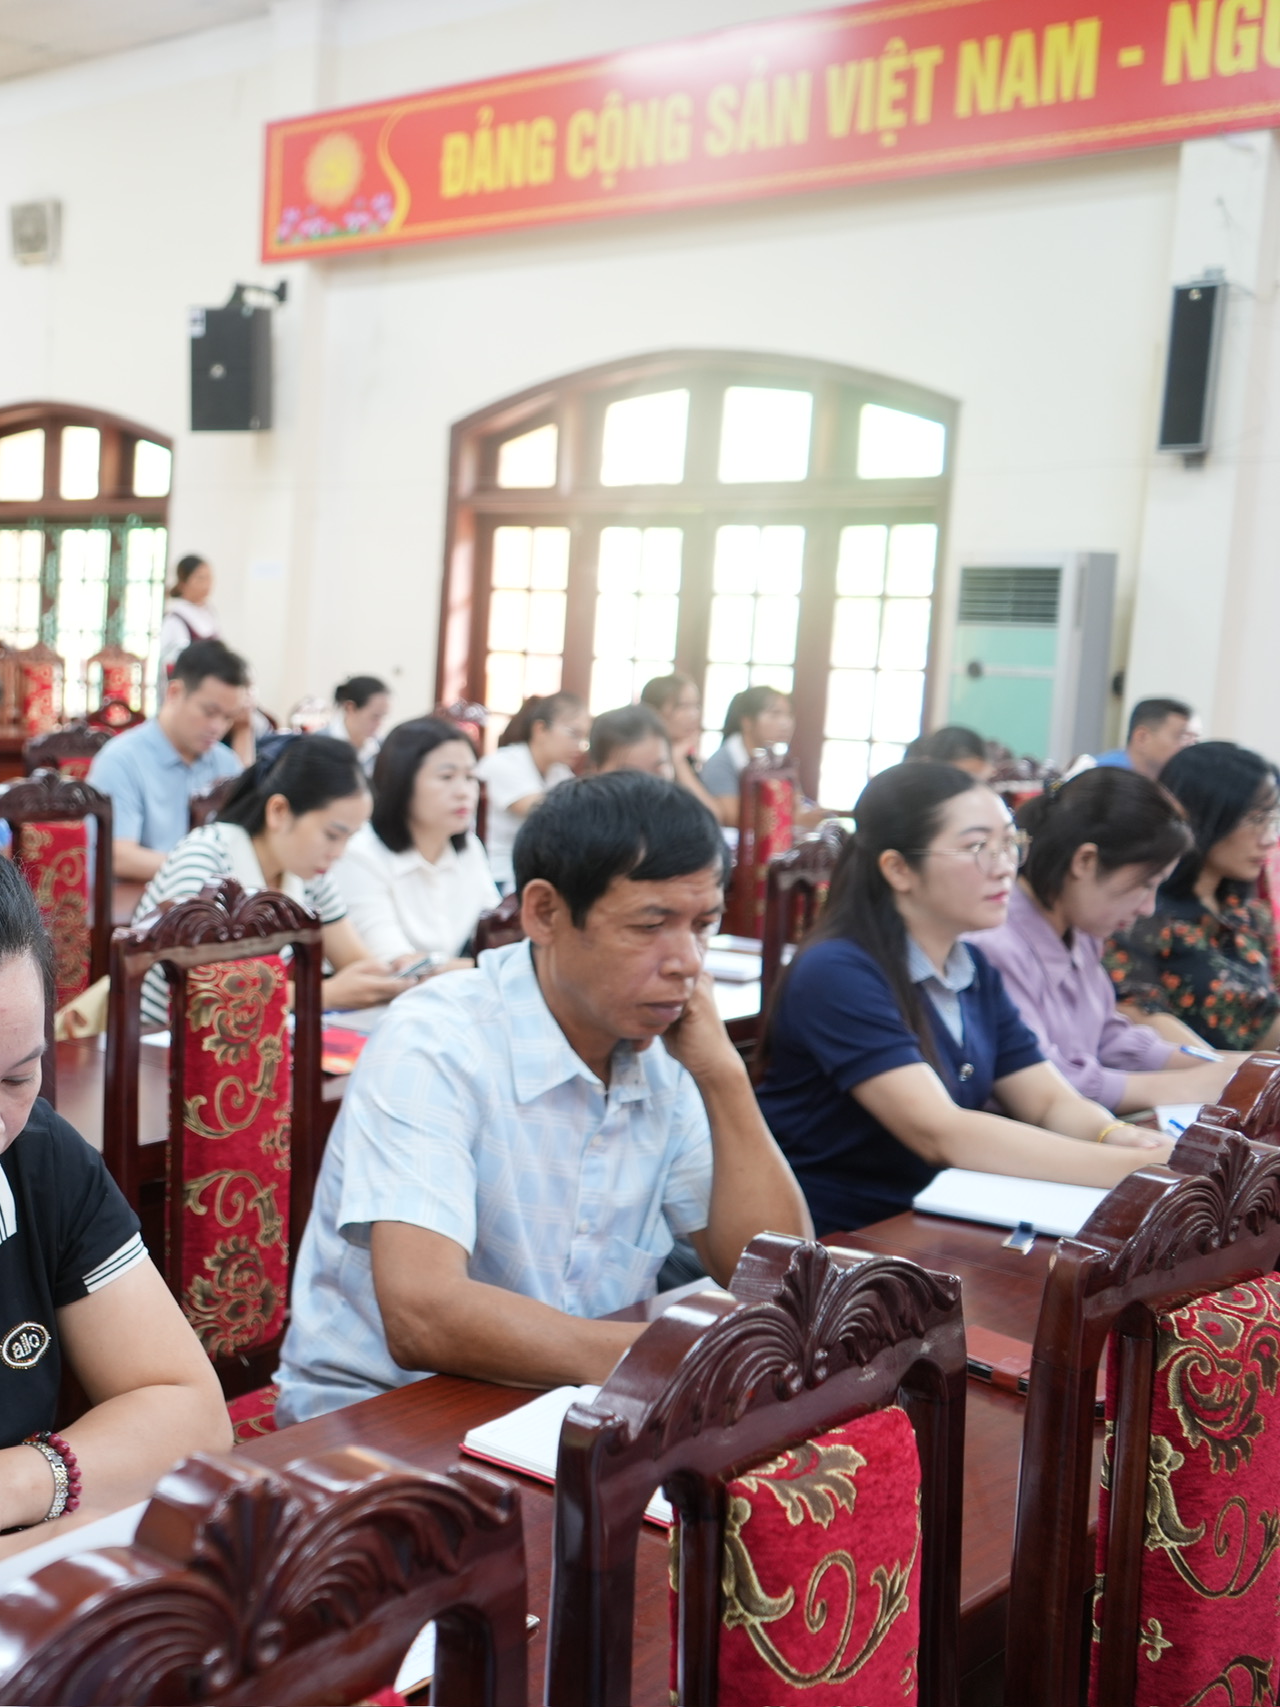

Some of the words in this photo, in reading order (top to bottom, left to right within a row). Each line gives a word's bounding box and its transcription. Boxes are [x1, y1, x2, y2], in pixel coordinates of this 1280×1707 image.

[439, 104, 558, 198] ĐẢNG
[565, 89, 694, 190] CỘNG
[704, 55, 814, 158] SẢN
[825, 36, 945, 147] VIỆT
[954, 16, 1103, 119] NAM
[1117, 46, 1145, 68] -
